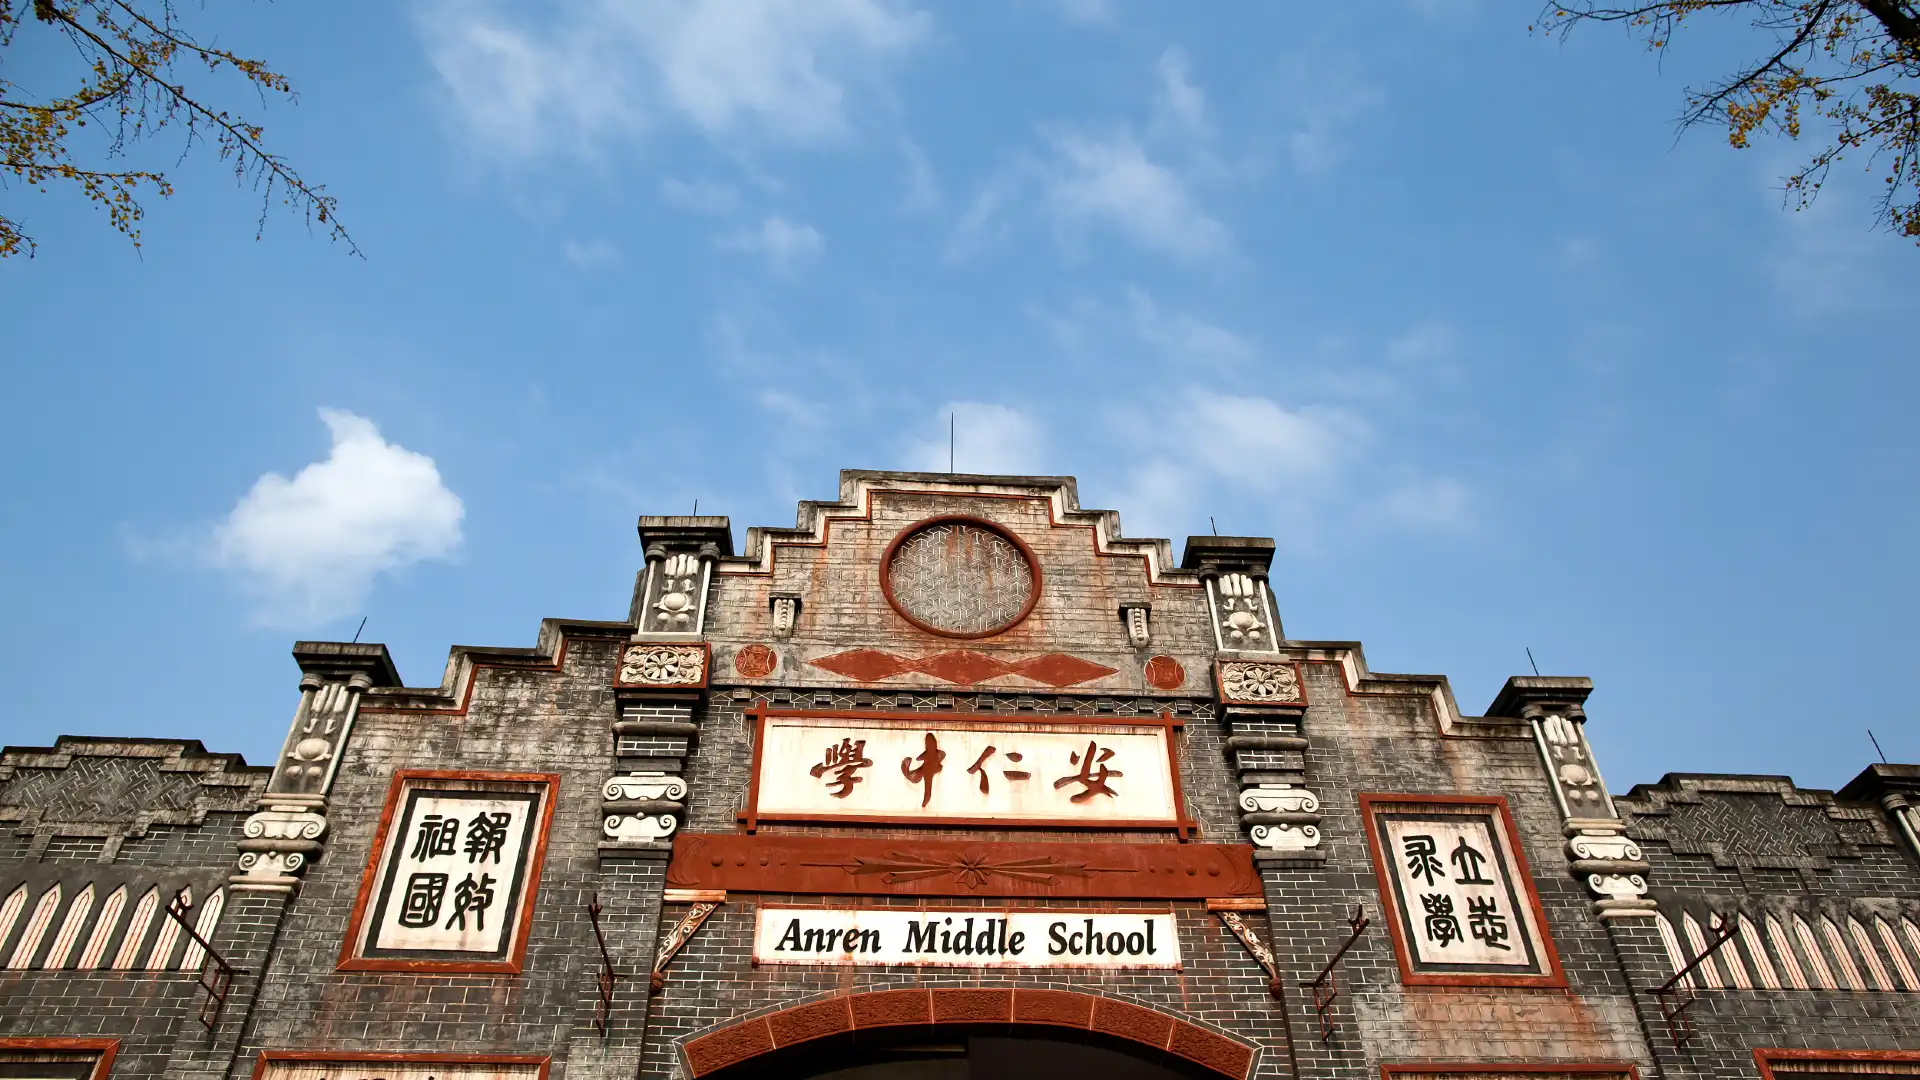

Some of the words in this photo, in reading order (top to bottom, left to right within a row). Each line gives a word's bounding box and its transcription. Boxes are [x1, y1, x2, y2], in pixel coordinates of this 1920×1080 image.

[810, 732, 1124, 808] 安仁中學
[774, 918, 882, 954] Anren
[904, 917, 1026, 956] Middle
[1047, 918, 1157, 956] School
